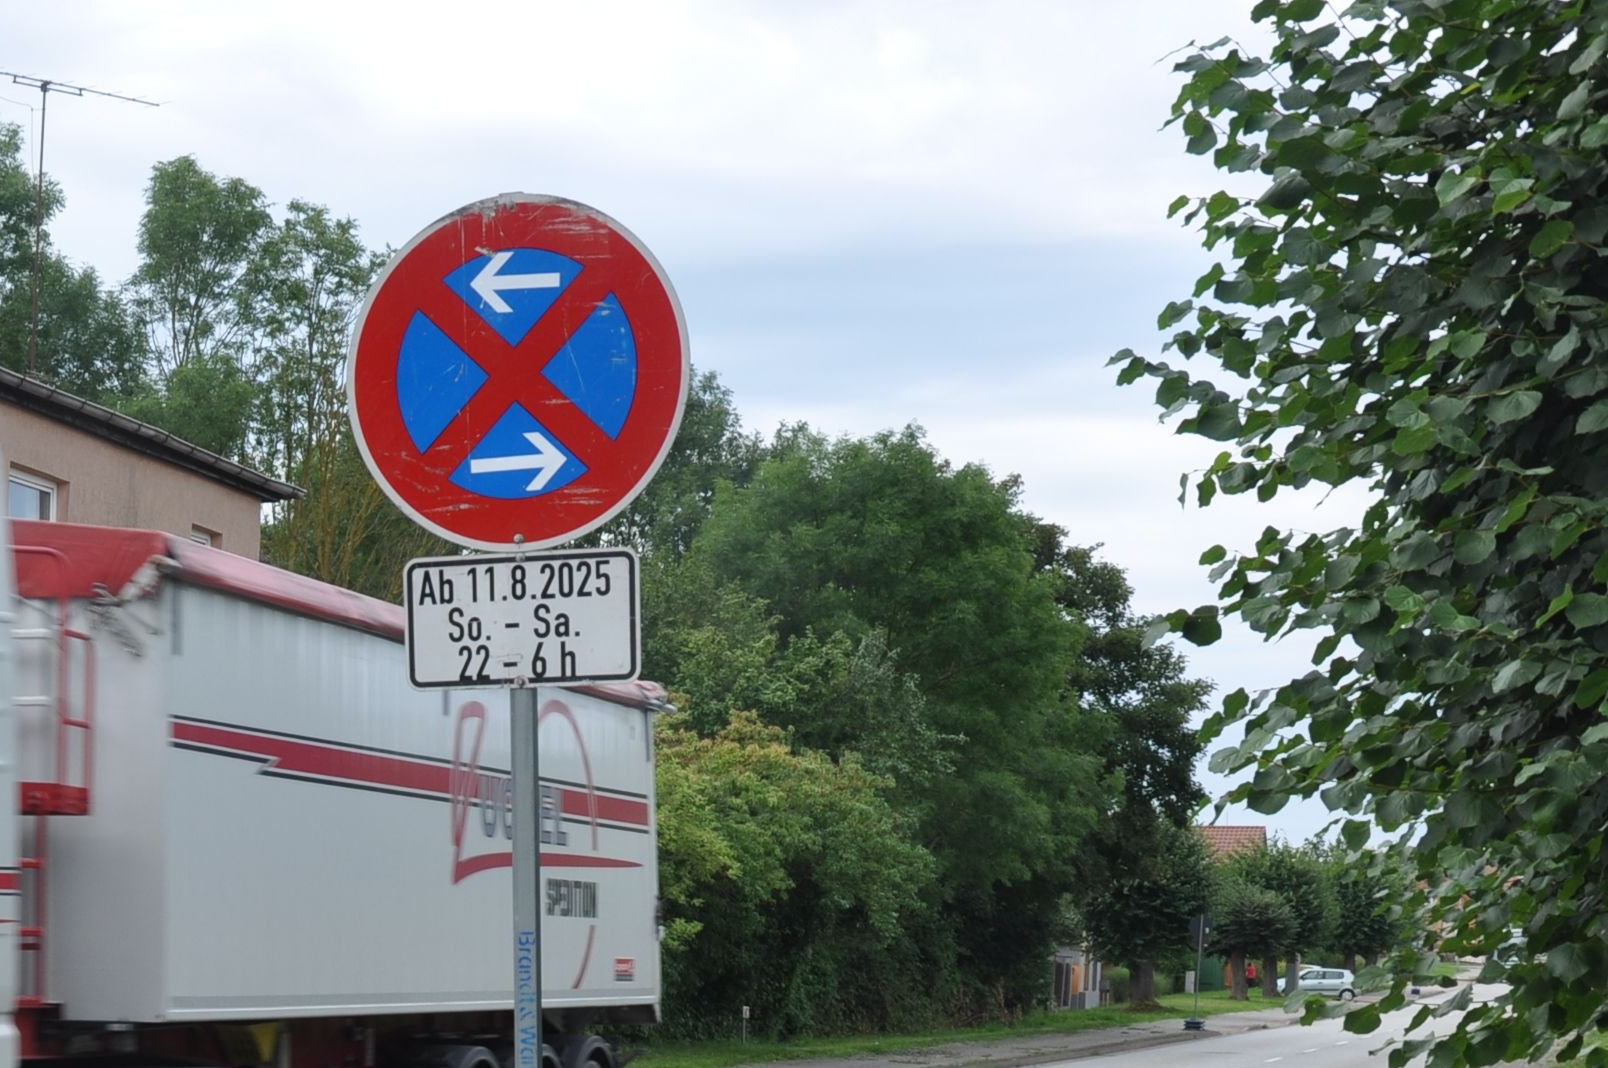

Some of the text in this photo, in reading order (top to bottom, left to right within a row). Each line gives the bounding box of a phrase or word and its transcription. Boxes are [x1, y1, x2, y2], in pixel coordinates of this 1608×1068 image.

[418, 559, 611, 606] Ab 11.8.2025
[448, 606, 492, 643] So.
[533, 603, 581, 638] Sa.
[458, 644, 491, 681] 22
[531, 641, 547, 678] 6
[560, 640, 577, 678] h
